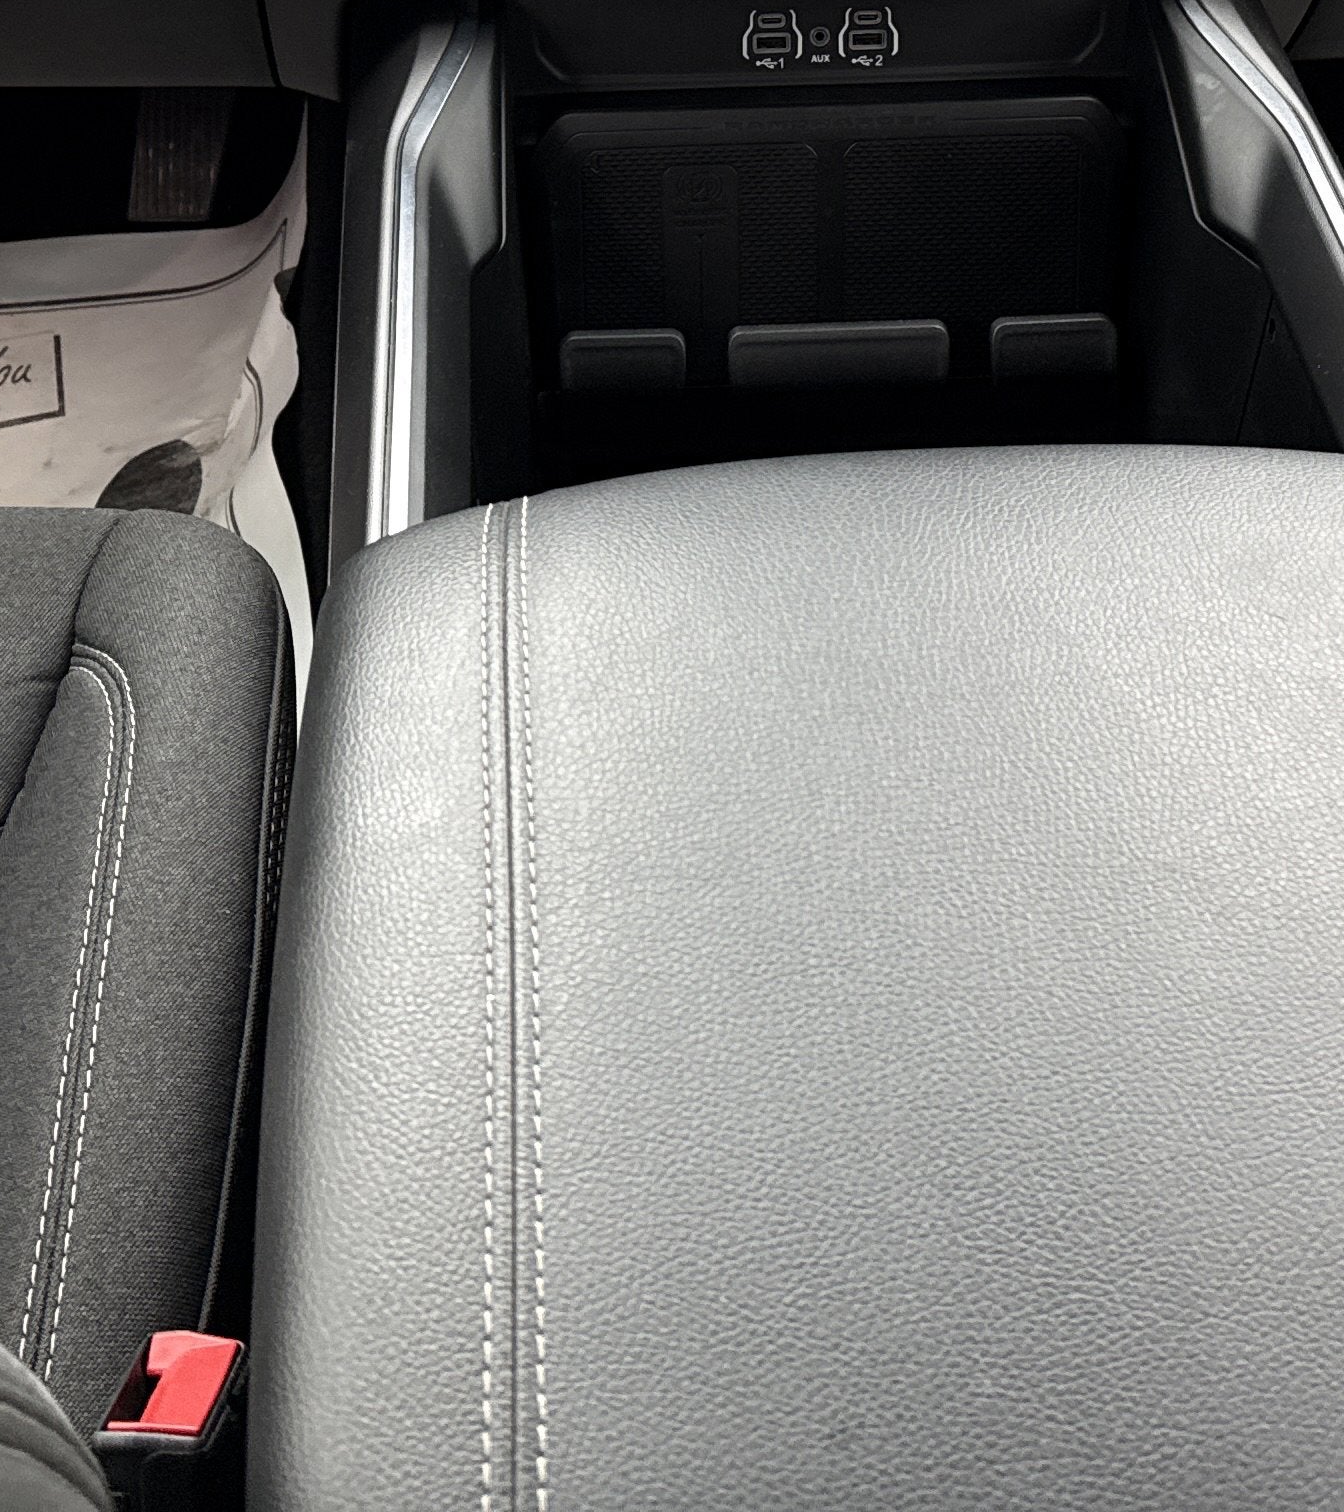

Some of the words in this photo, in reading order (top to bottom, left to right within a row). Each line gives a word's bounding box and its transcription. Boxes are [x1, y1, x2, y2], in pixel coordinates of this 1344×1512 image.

[778, 58, 785, 69] 1
[811, 54, 831, 63] AUX
[874, 55, 883, 66] 2
